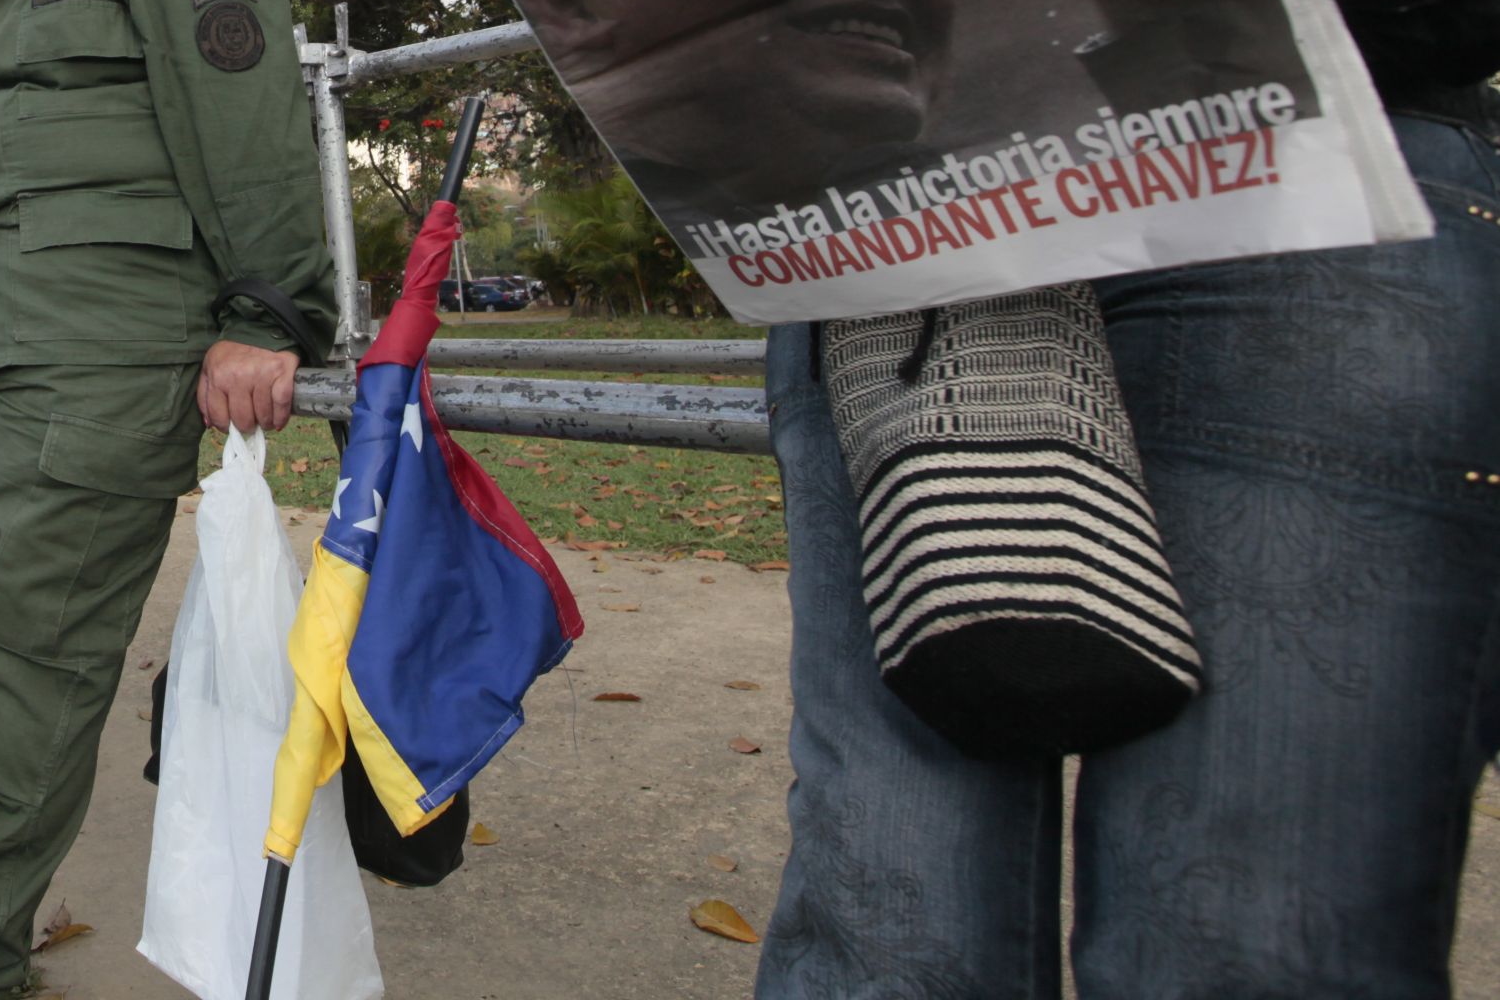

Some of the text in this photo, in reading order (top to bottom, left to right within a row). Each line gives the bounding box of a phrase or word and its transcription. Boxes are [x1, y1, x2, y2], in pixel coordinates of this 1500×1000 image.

[685, 82, 1296, 258] ¡Hasta la victoria siempre
[727, 126, 1280, 287] COMANDANTE CHÁVEZ!
